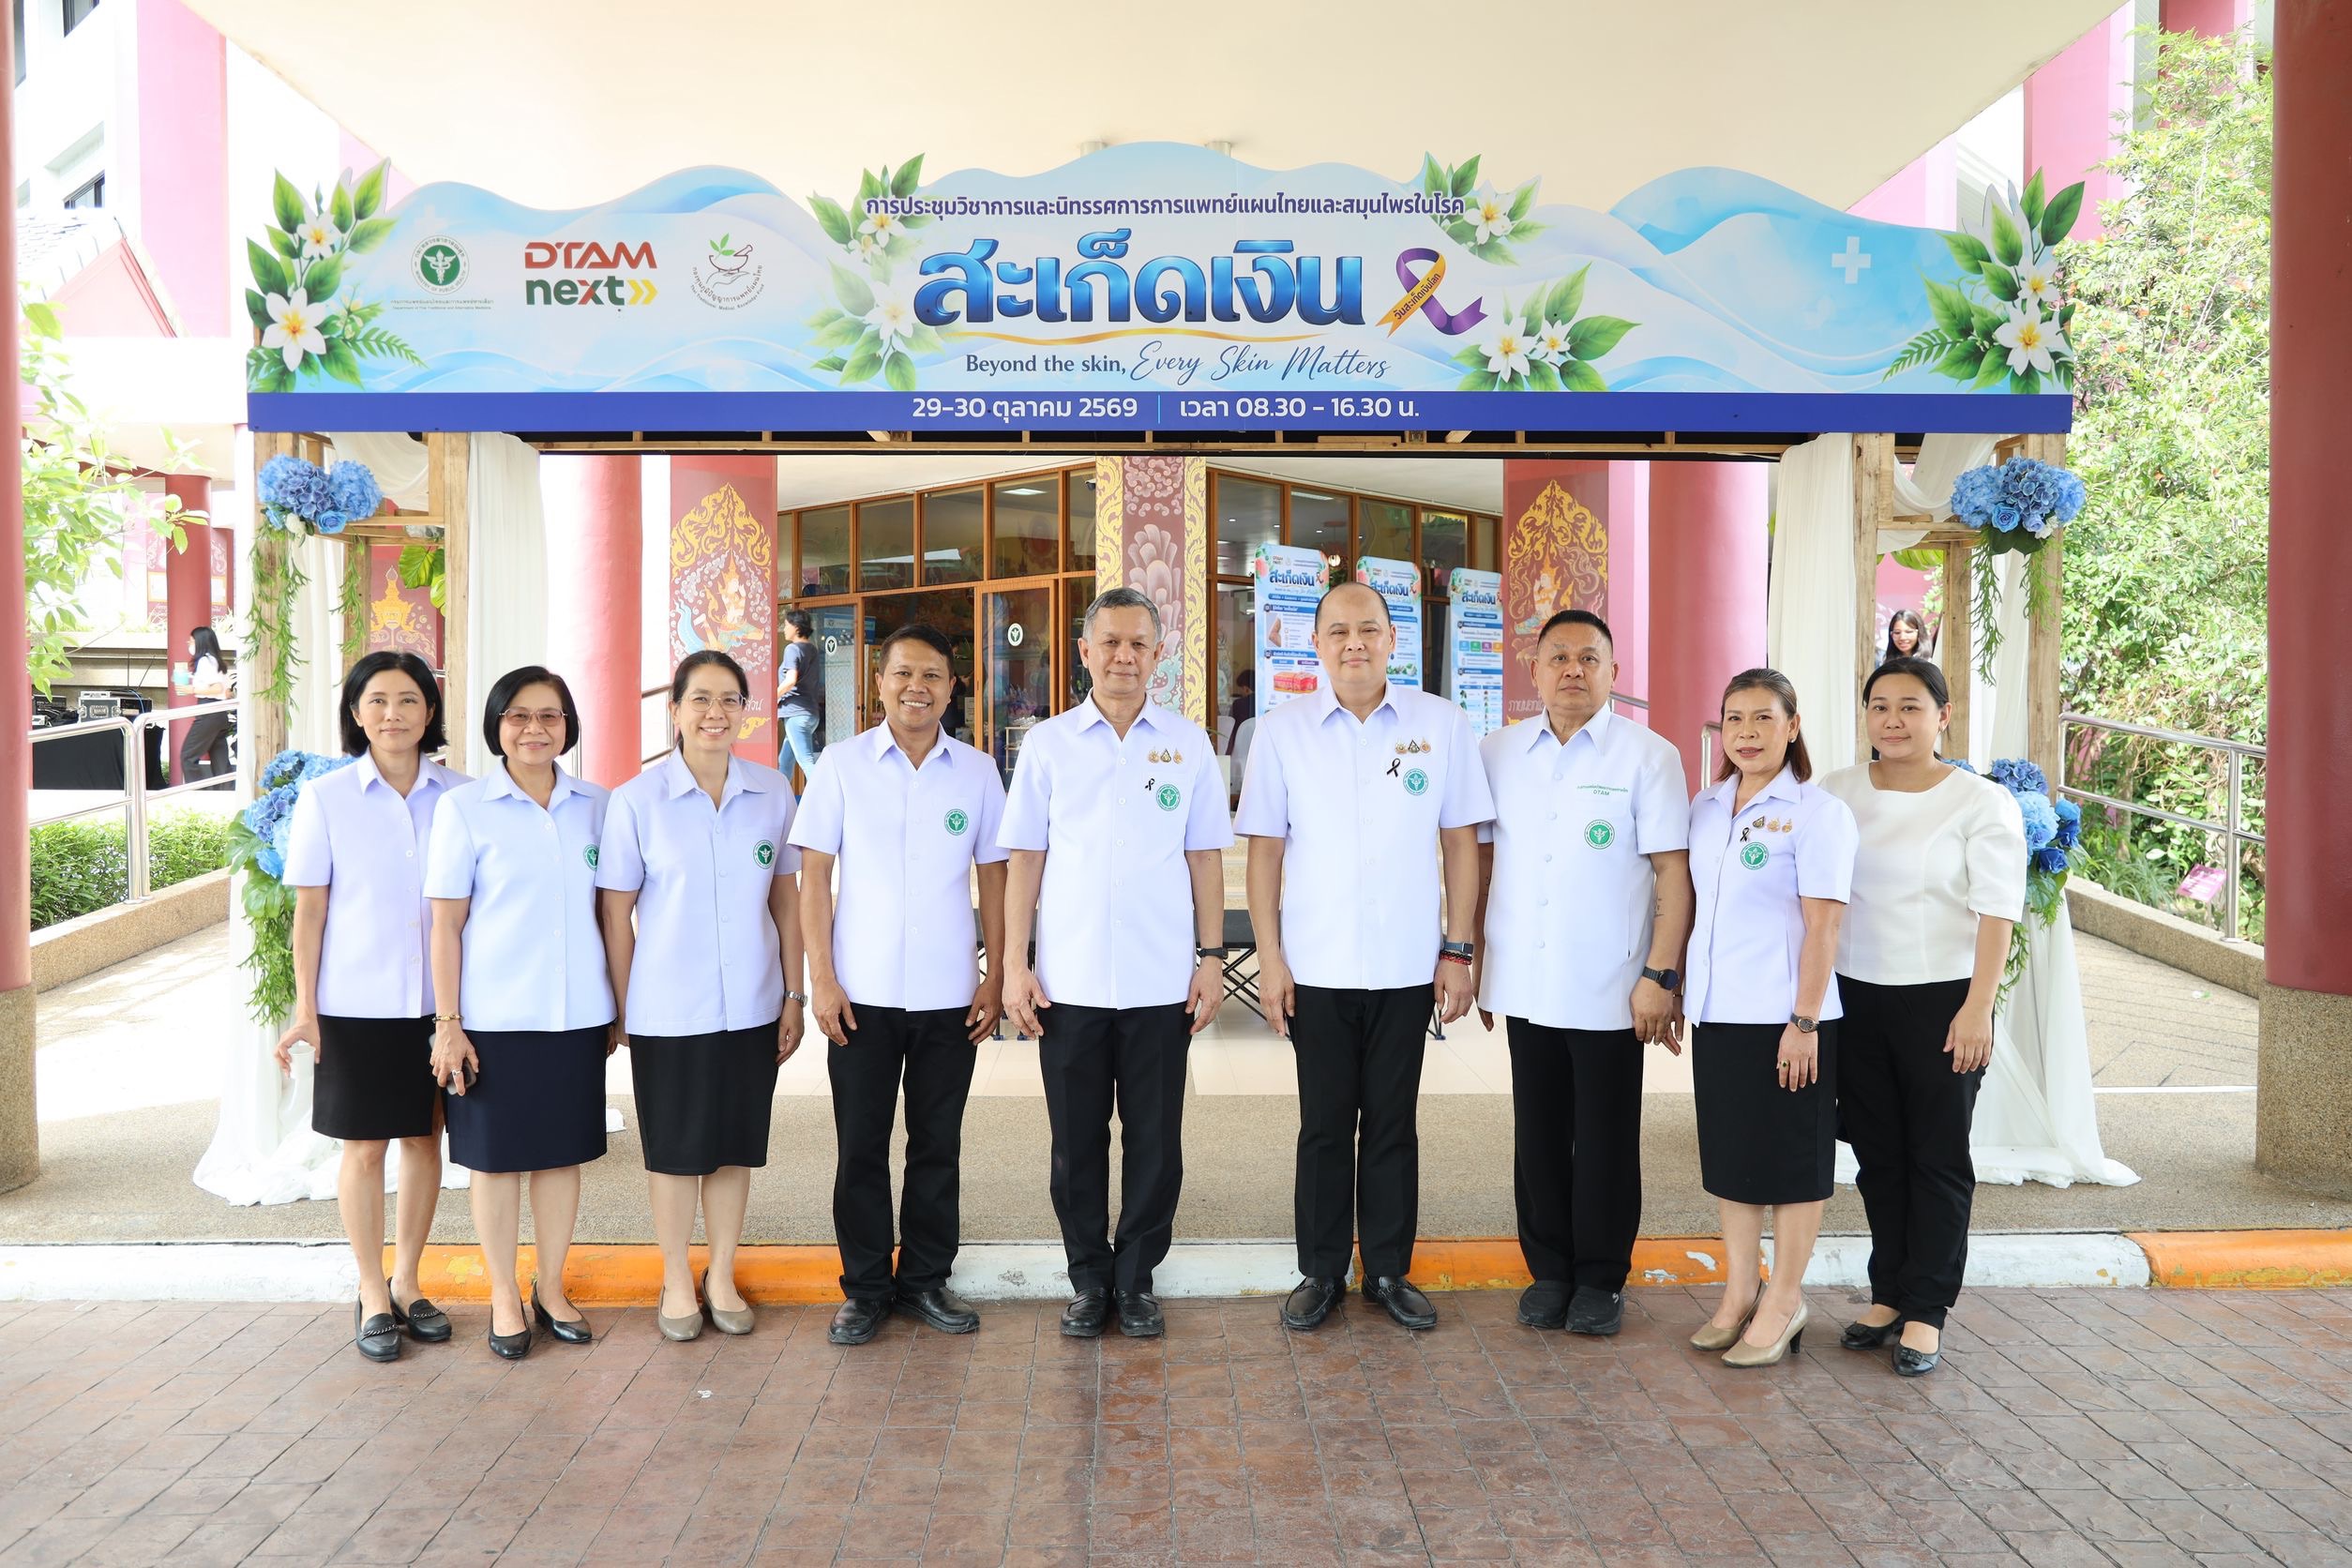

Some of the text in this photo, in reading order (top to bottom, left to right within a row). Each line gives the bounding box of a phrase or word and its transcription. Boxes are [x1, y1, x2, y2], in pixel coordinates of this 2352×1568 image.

[866, 191, 1465, 221] การประชุมวิชาการและนิทรรศการการแพทย์แผนไทยและสมุนไพรในโรค
[524, 241, 657, 269] DTAM
[525, 275, 625, 306] next
[913, 228, 1365, 326] สะเก็ดเงิน
[1393, 273, 1441, 320] วันสะเก็ดเงินโลก
[966, 340, 1392, 385] Beyond the skin, Every Skin Matters
[912, 398, 1138, 424] 29-30 ตุลาคม 2569
[1180, 400, 1229, 417] เวลา
[1235, 398, 1306, 417] 08.30
[1331, 398, 1392, 417] 16.30
[1398, 400, 1420, 417] น.
[1269, 569, 1315, 587] สะเก็ดเงิน
[1461, 590, 1497, 606] สะเก็ดเงิน
